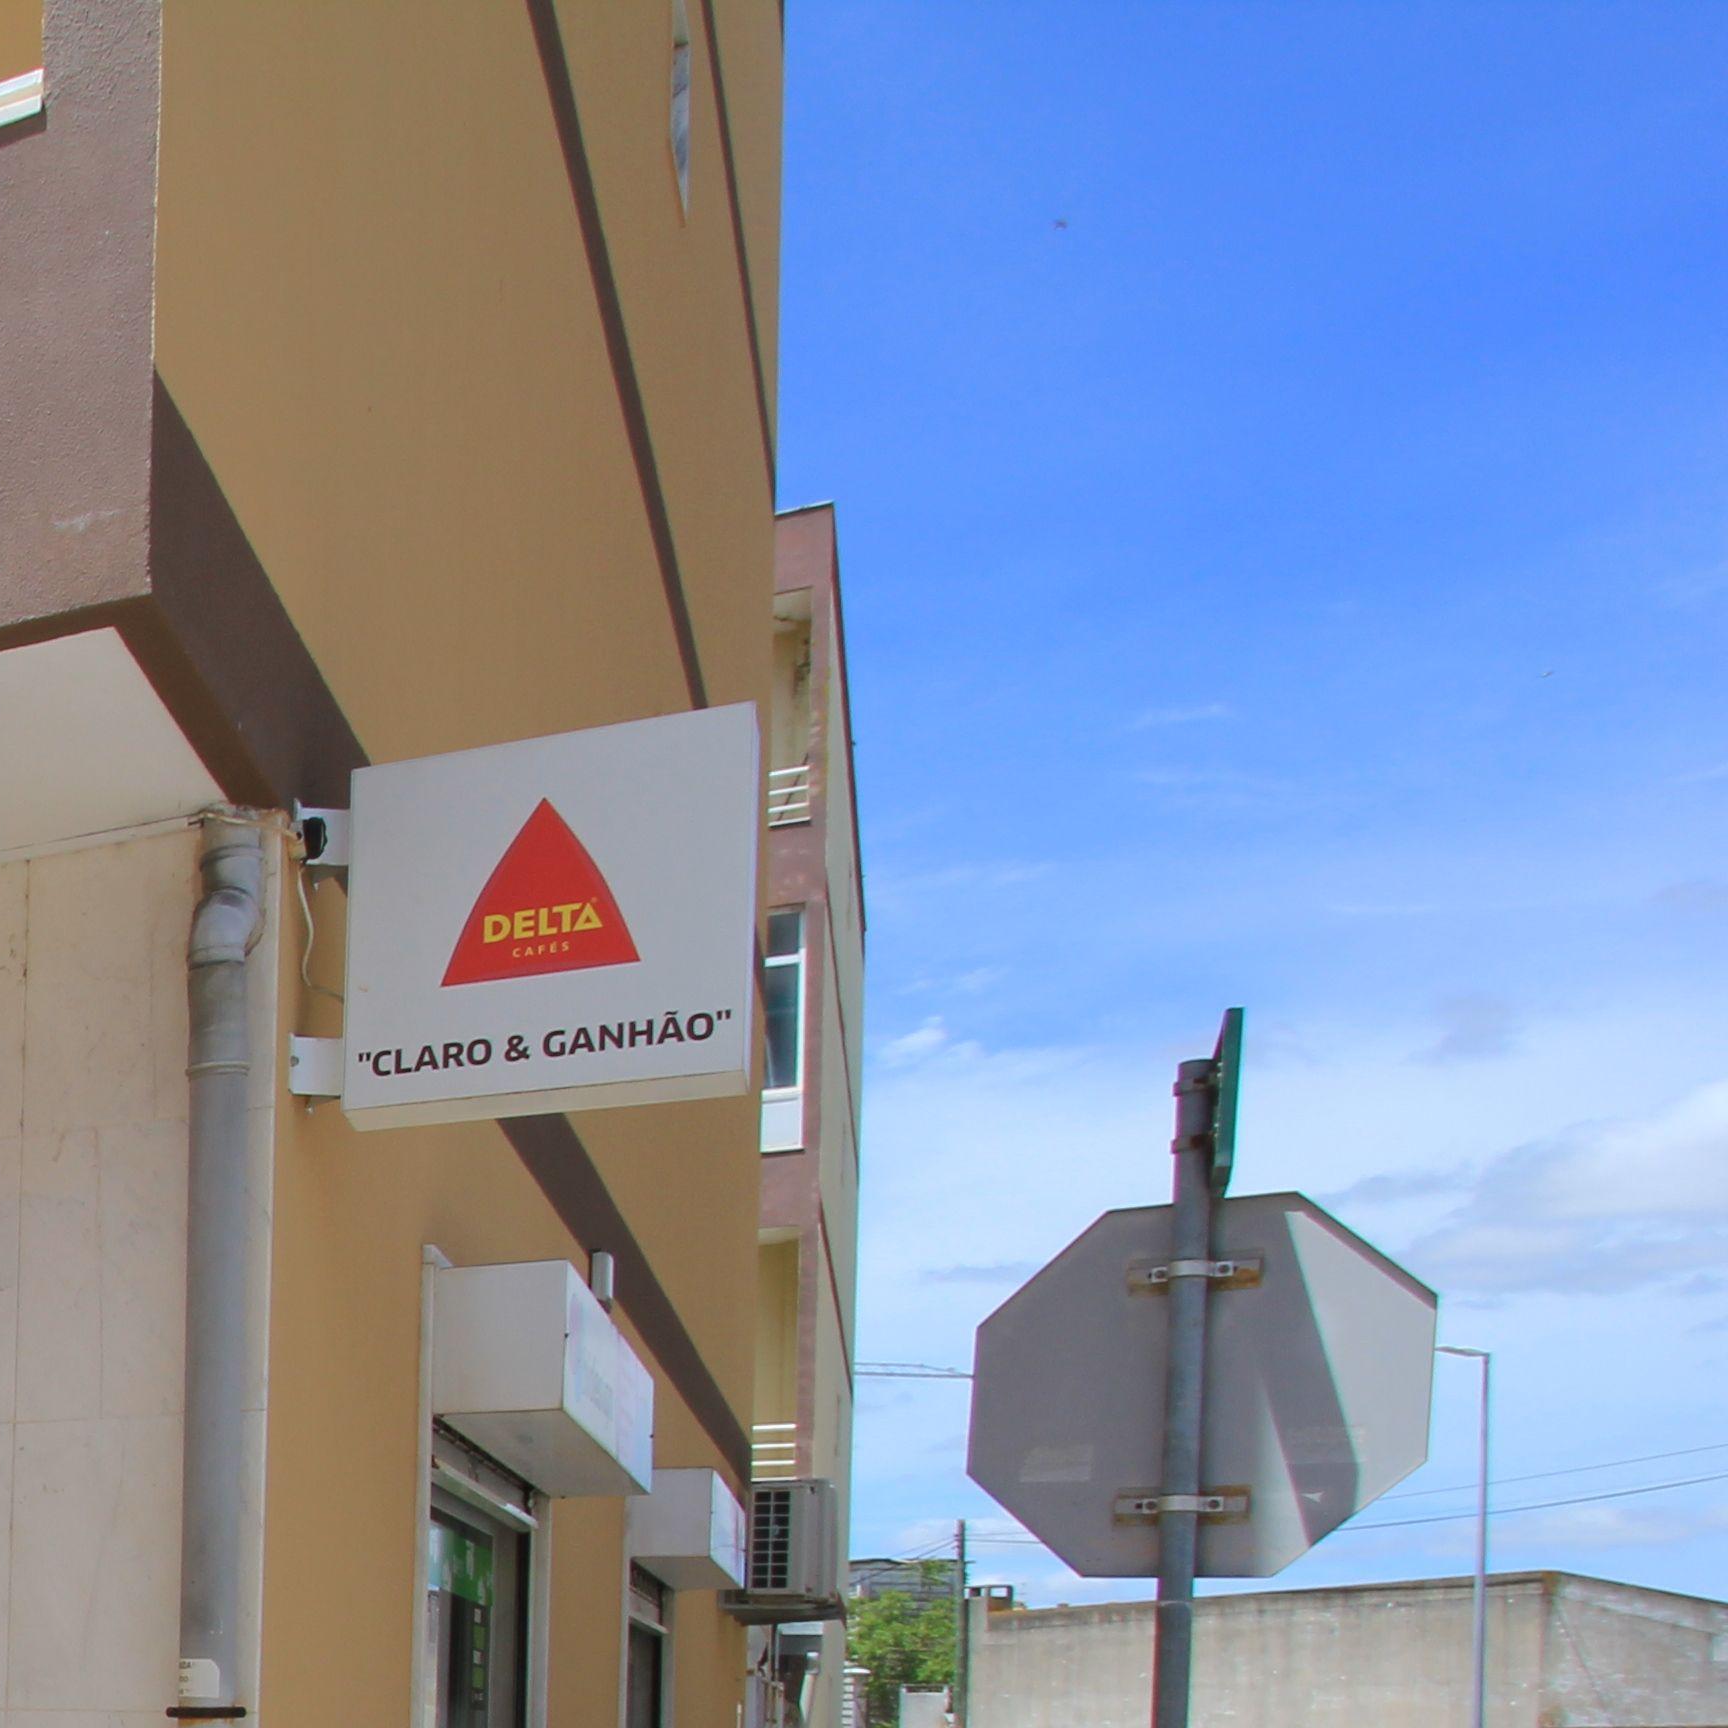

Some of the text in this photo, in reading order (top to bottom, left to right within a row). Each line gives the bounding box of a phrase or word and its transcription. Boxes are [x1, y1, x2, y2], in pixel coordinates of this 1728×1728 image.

[482, 901, 604, 944] DELTA
[511, 940, 571, 958] CAFÉS
[357, 1008, 733, 1078] "CLARO & GANHÃO"
